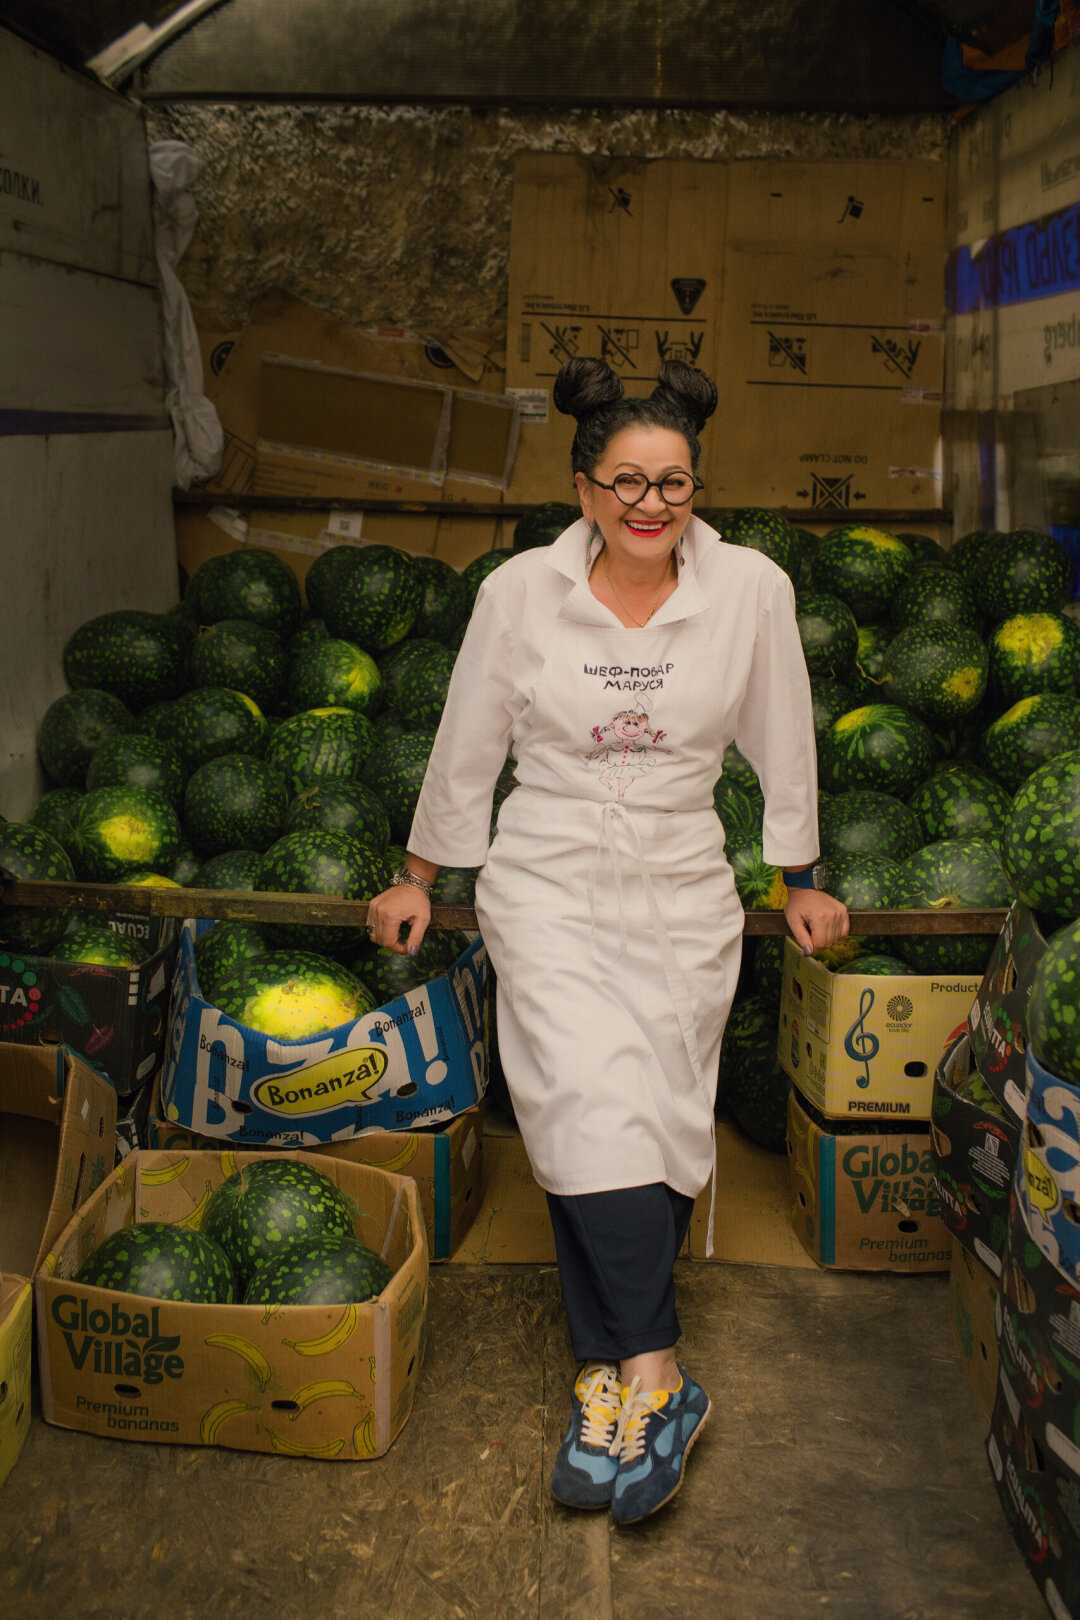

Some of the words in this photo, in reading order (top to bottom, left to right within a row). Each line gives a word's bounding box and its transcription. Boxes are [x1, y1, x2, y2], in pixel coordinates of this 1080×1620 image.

[799, 453, 831, 463] CLAMP
[833, 454, 853, 464] NOT
[854, 454, 868, 465] DO
[603, 678, 664, 691] МАРУСЯ
[375, 1001, 426, 1037] Bonanza!
[200, 1034, 250, 1071] Bonanza!
[268, 1053, 379, 1107] Bonanza!
[396, 1096, 456, 1123] Bonanza!
[848, 1101, 911, 1114] PREMIUM
[239, 1124, 305, 1141] Bonanza!
[843, 1144, 936, 1178] Globa
[859, 1238, 928, 1250] Premium
[888, 1250, 952, 1263] bananas
[60, 1331, 185, 1385] Village
[76, 1395, 149, 1417] Premium
[107, 1413, 180, 1432] bananas
